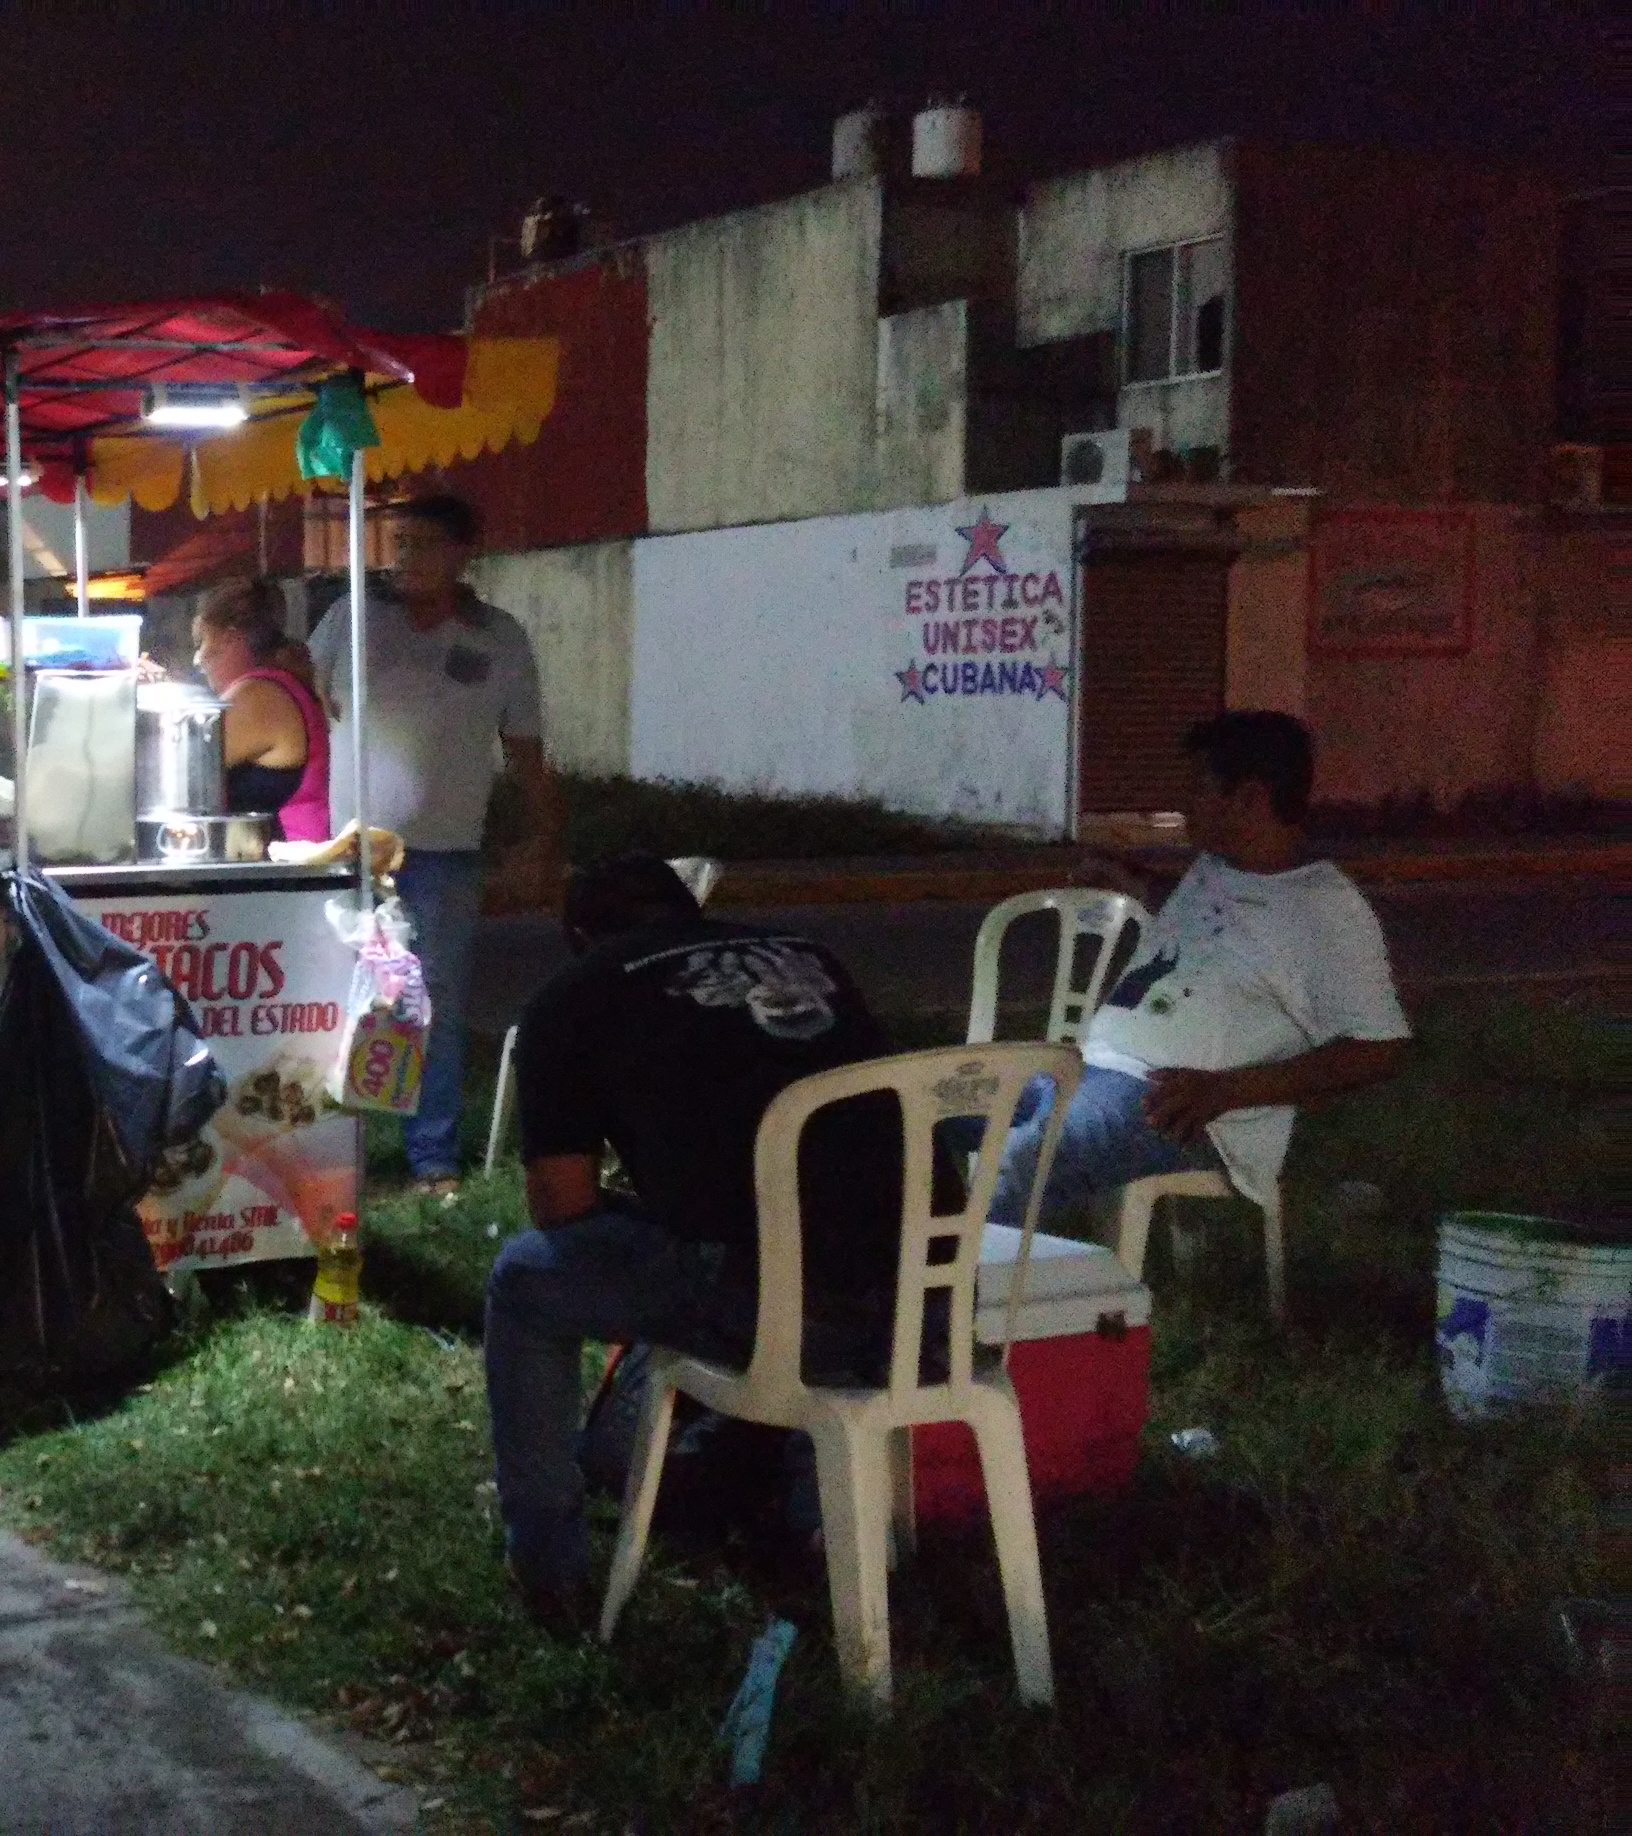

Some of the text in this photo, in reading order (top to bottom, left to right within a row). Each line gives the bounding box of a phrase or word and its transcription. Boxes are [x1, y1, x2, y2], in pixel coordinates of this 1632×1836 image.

[906, 572, 1063, 615] ESTETICA
[923, 617, 1039, 655] UNISEX
[921, 661, 1038, 695] CUBANA
[151, 941, 285, 1002] TACOS
[201, 1001, 340, 1037] DEL ESTADO
